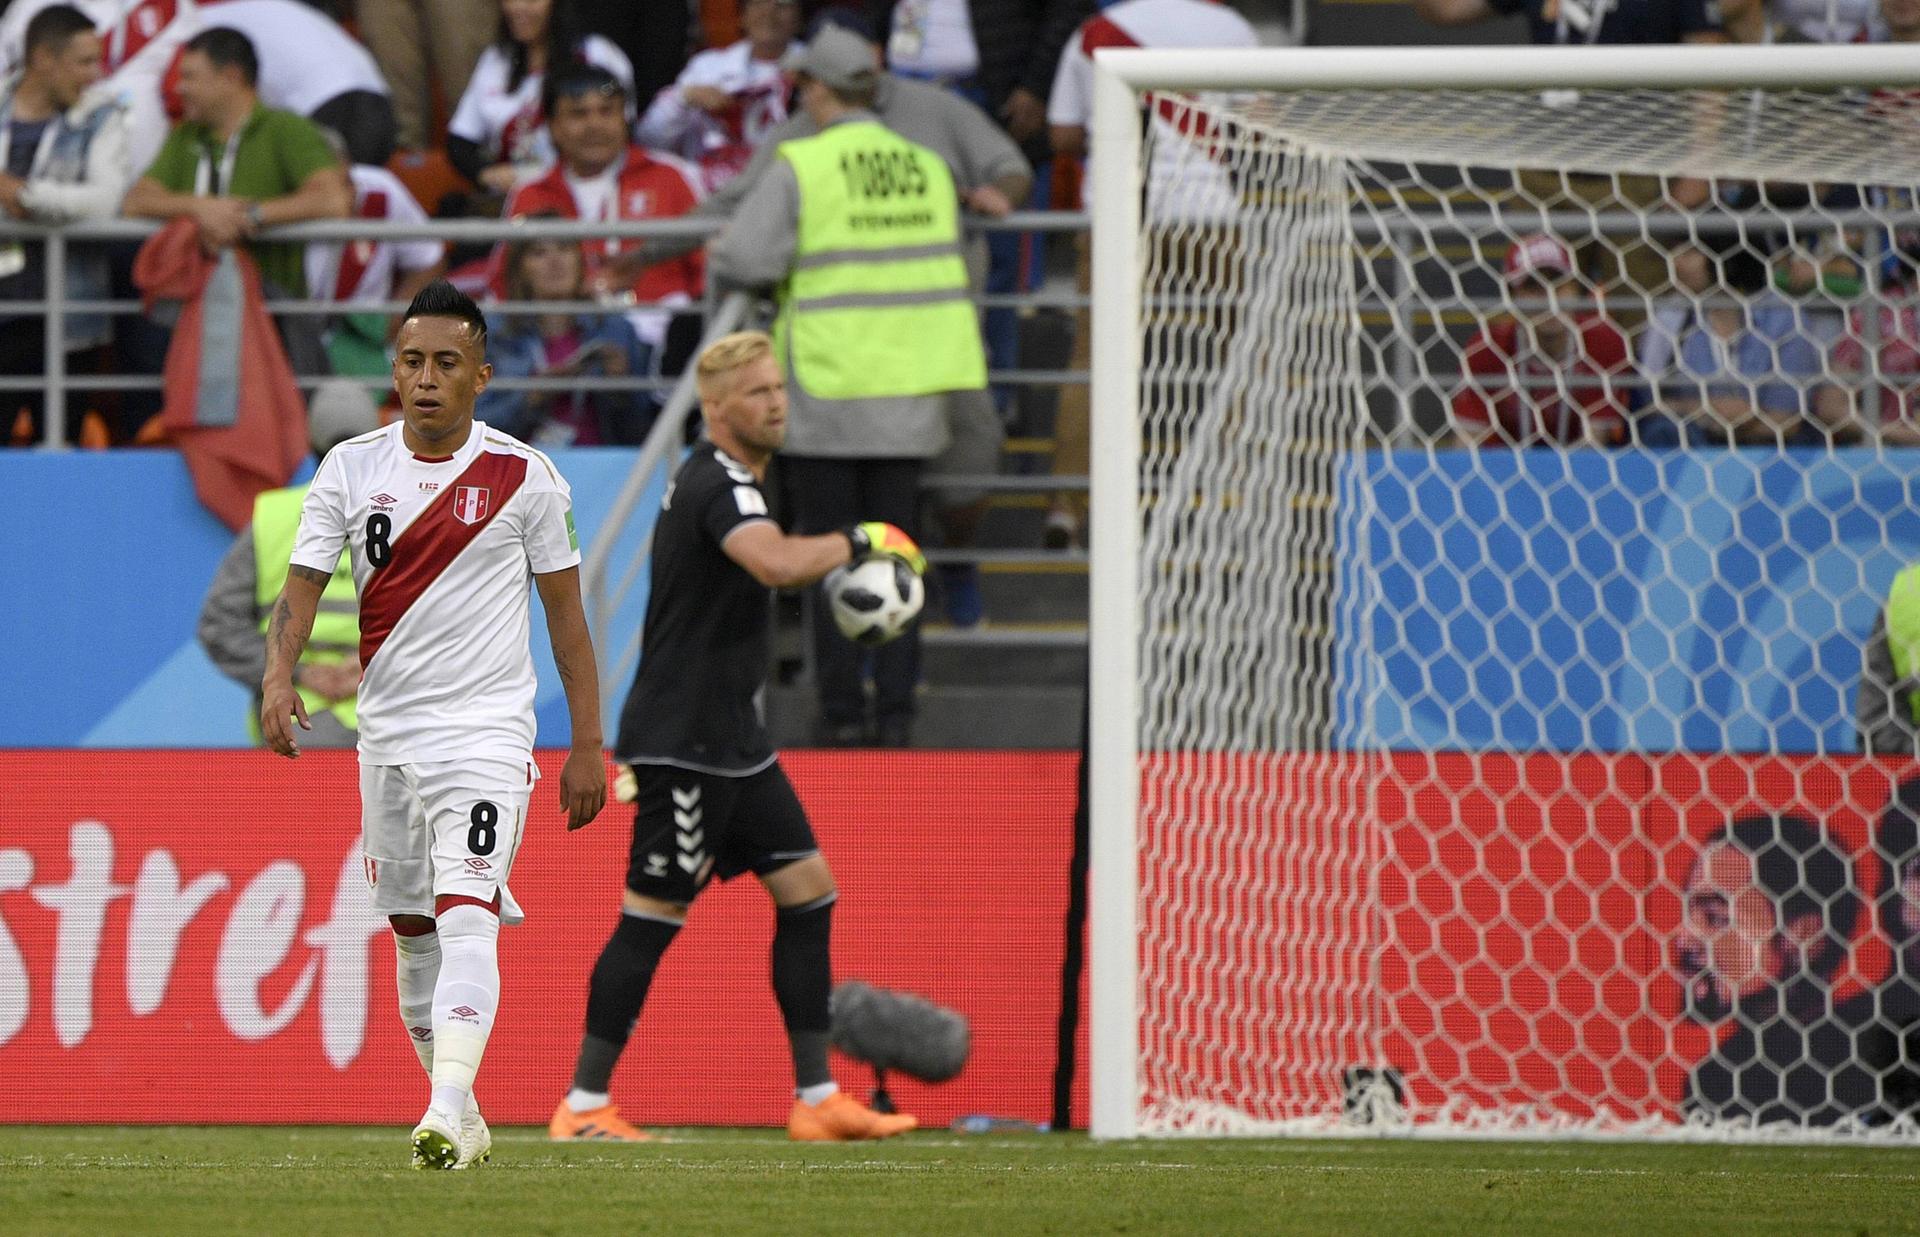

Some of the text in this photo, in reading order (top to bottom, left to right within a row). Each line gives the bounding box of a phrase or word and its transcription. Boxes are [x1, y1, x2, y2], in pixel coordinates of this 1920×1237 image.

[370, 504, 394, 512] umbro
[366, 513, 392, 568] 8
[467, 801, 498, 856] 8
[464, 868, 488, 879] umbro
